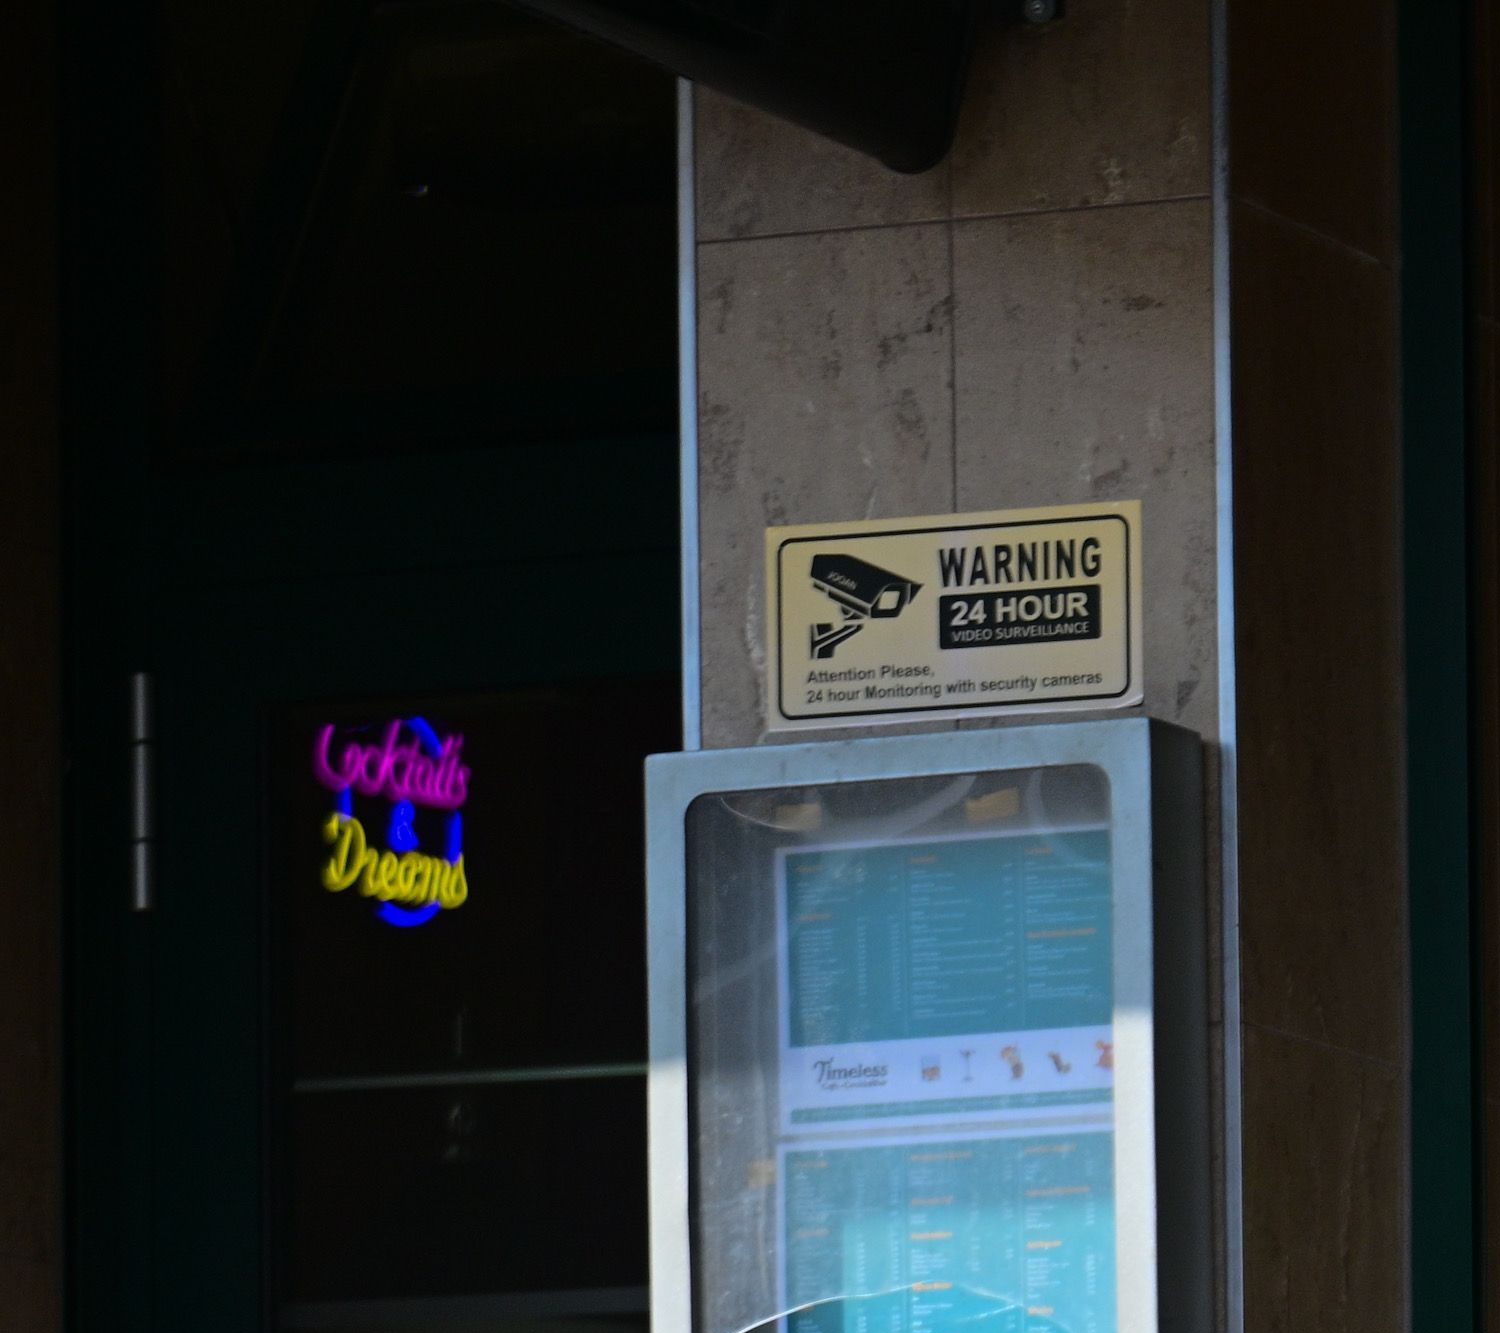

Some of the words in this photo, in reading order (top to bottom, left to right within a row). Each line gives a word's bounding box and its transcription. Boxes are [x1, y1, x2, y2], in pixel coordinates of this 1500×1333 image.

[938, 537, 1102, 588] WARNING
[951, 600, 987, 626] 24
[995, 592, 1089, 622] HOUR
[952, 628, 993, 643] VIDEO
[995, 622, 1091, 641] SURVEILLANCE
[807, 666, 876, 684] Attention
[881, 663, 935, 679] Please,
[807, 690, 823, 704] 24
[828, 688, 861, 702] hour
[865, 682, 942, 700] Monitoring
[947, 678, 976, 694] with
[980, 675, 1038, 693] security
[1042, 672, 1103, 688] cameras
[322, 812, 468, 909] Dreams
[813, 1057, 889, 1083] Timeless
